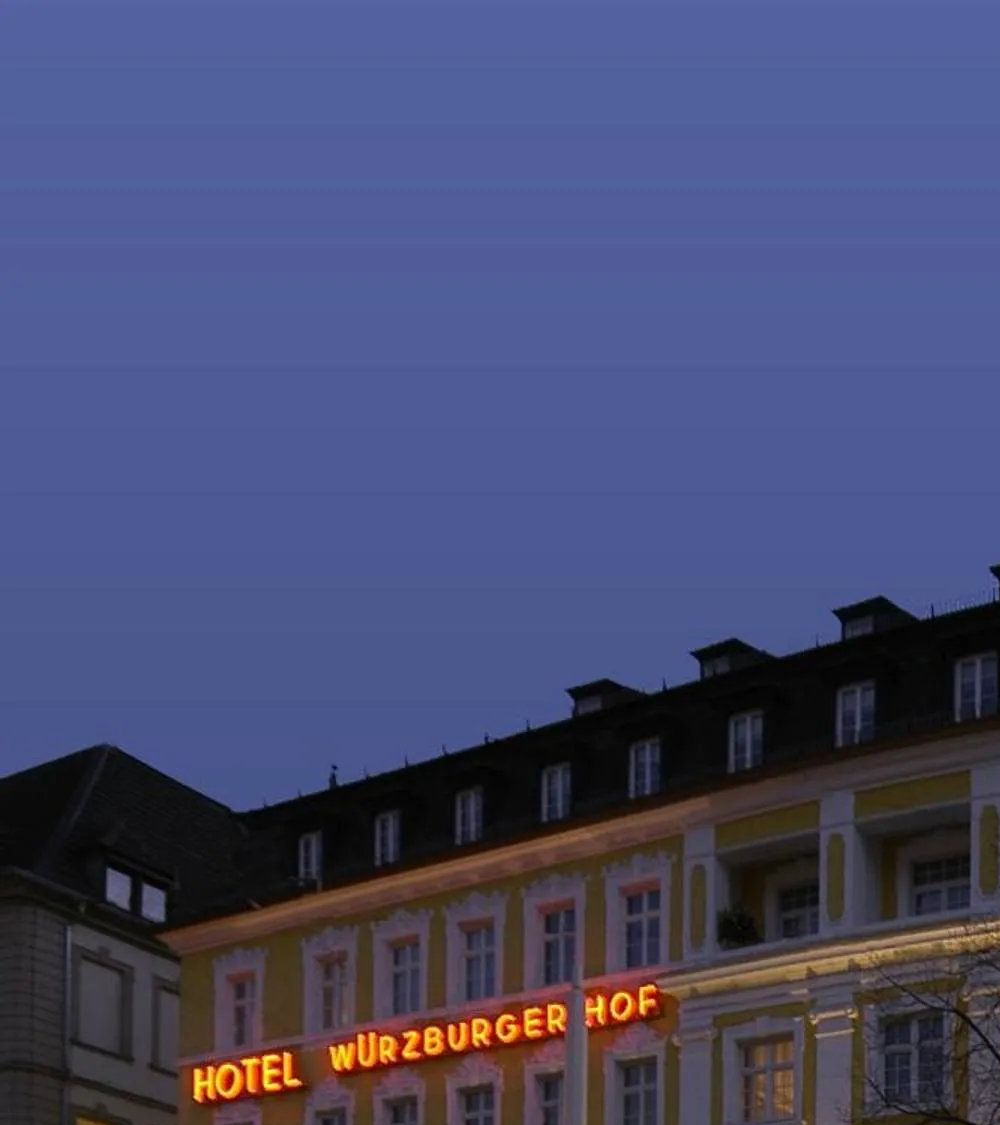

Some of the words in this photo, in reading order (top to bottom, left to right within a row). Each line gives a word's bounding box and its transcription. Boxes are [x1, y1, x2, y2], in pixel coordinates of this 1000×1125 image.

[192, 1052, 303, 1103] HOTEL
[328, 1003, 569, 1073] WÜRZBURGER
[584, 984, 659, 1028] HOF
